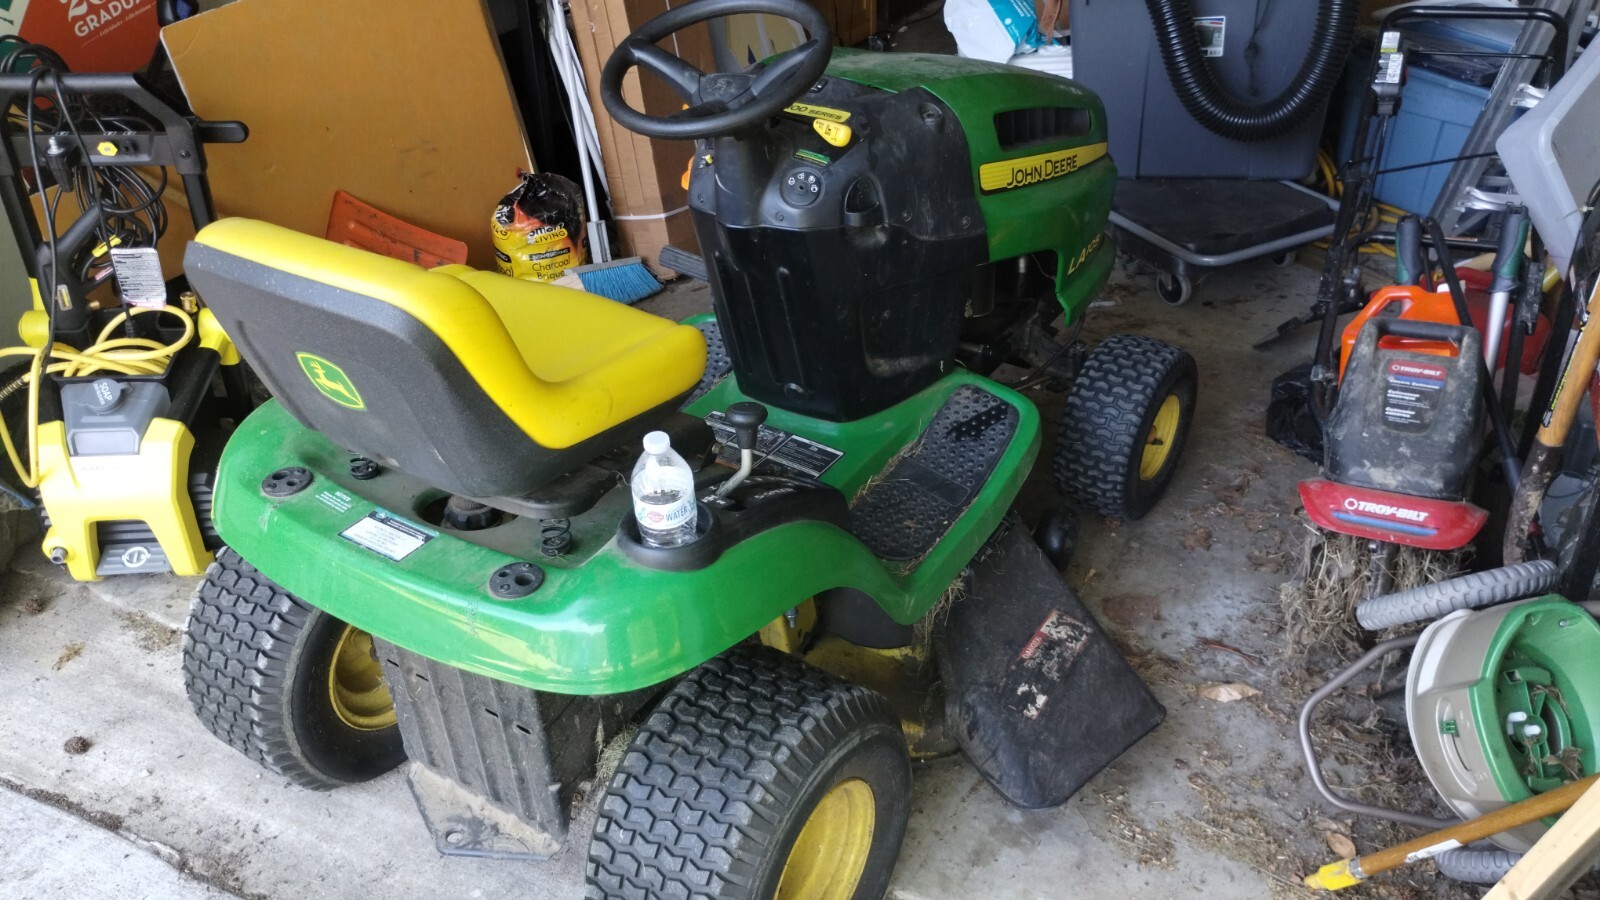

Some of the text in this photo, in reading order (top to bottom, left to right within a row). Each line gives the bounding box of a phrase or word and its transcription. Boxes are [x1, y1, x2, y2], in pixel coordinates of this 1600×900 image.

[74, 0, 140, 37] GRADU
[808, 109, 843, 120] SERIES
[1006, 154, 1078, 187] JOHN DEERE
[535, 230, 566, 244] LIVING
[531, 254, 571, 273] Charcoal
[536, 267, 567, 281] Brique
[99, 382, 113, 401] SOAP
[665, 504, 688, 522] WATER
[1358, 500, 1428, 522] TROY-BILT
[1021, 636, 1043, 660] DANGER
